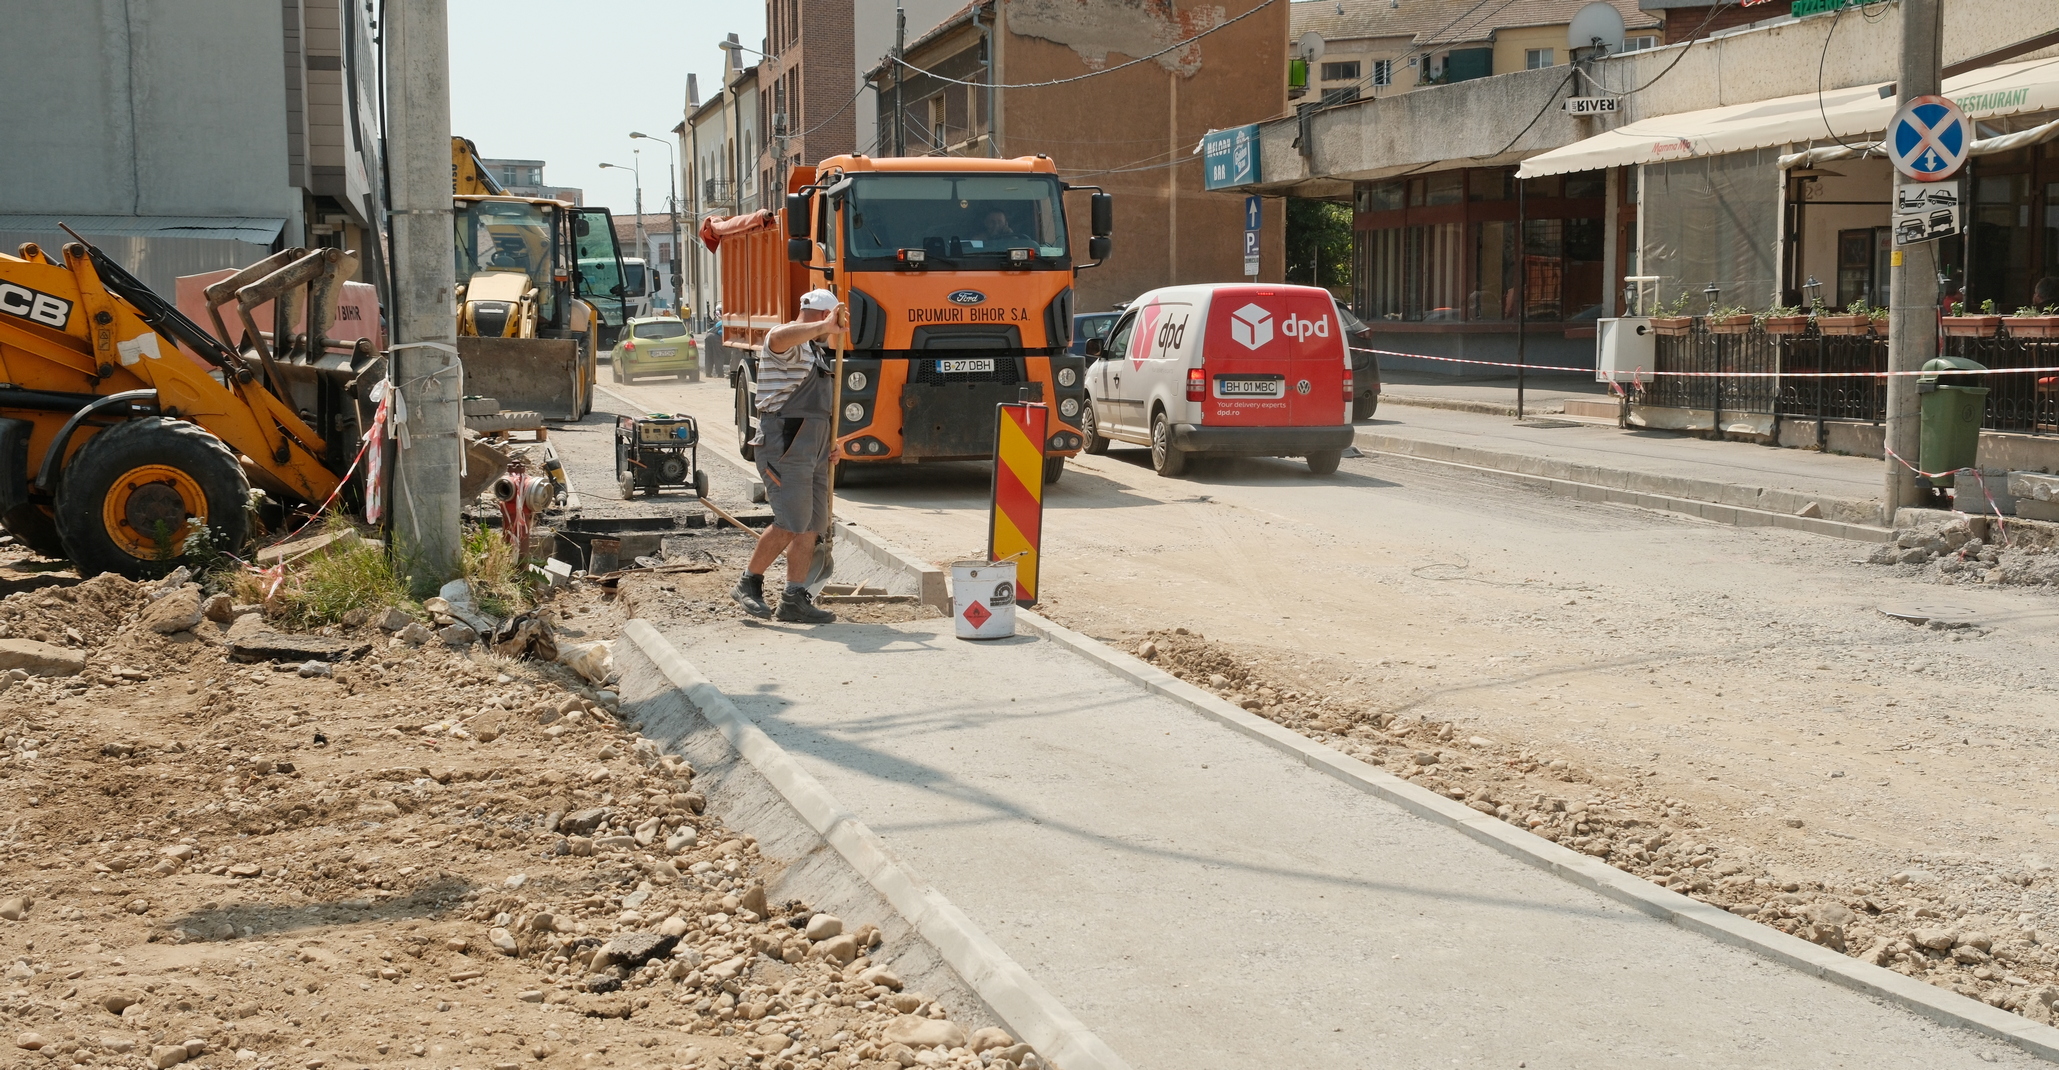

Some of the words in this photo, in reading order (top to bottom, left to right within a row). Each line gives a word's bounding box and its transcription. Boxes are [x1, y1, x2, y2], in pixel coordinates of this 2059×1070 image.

[1213, 164, 1226, 181] BAR
[1246, 232, 1255, 254] P
[0, 283, 69, 327] CB
[957, 291, 979, 303] Ford
[908, 308, 963, 322] DRUMURI
[970, 308, 1005, 321] BIHOR
[1011, 307, 1031, 321] S.A.
[1158, 313, 1189, 358] dpd
[1281, 313, 1329, 343] dpd
[943, 361, 952, 371] B
[954, 361, 967, 371] 27
[969, 360, 991, 371] DBH
[1226, 382, 1241, 392] BH
[1243, 382, 1253, 392] 01
[1254, 382, 1275, 392] MBC
[1234, 401, 1261, 409] delivery
